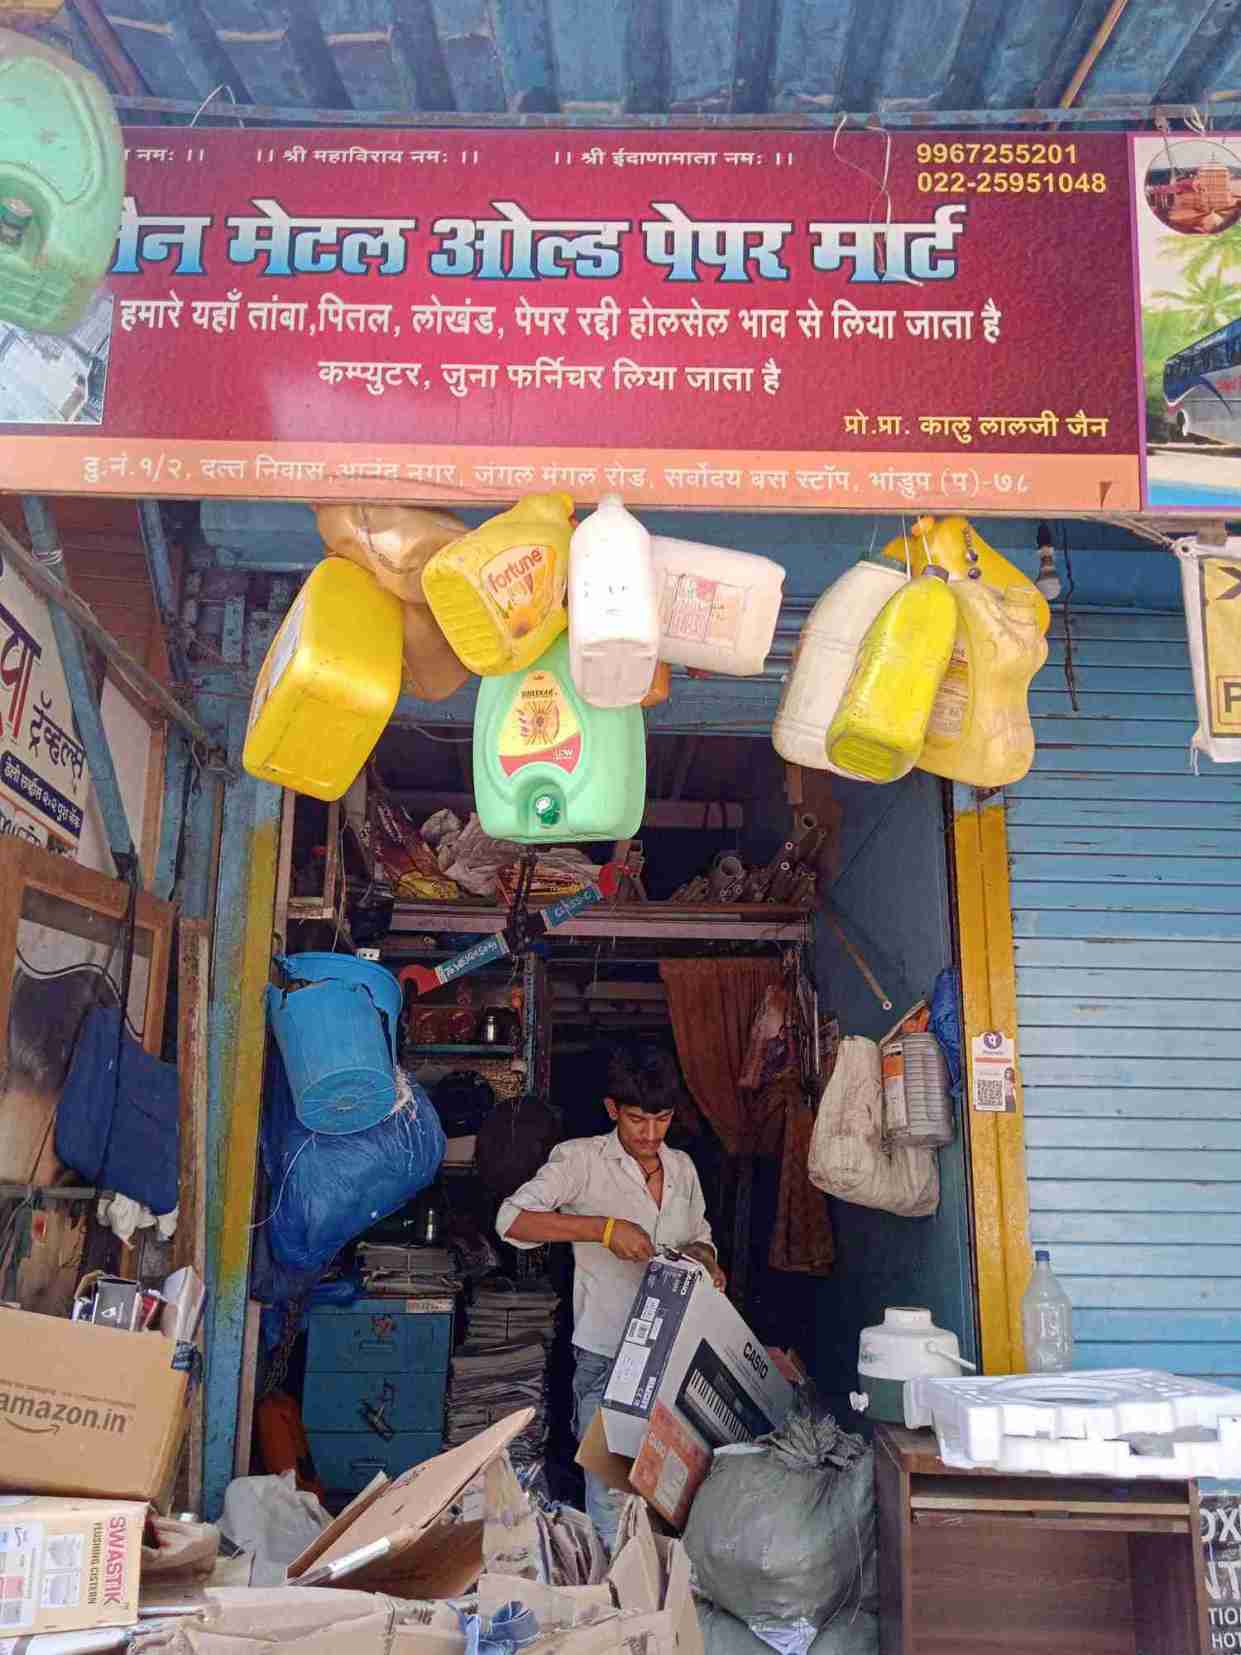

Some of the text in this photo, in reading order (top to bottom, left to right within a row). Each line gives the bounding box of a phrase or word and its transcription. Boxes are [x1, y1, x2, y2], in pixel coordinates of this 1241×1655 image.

[282, 145, 306, 164] श्री
[314, 146, 402, 165] महाविराय
[581, 147, 606, 167] श्री
[916, 143, 1078, 166] 9967255201
[916, 171, 1107, 195] 022-25951048
[226, 198, 417, 276] मेटल
[431, 202, 631, 281] ओल्ड
[642, 202, 794, 283] पेपर
[808, 204, 968, 284] मार्ट
[119, 289, 184, 331] हमारे
[191, 288, 240, 333] यहाँ
[514, 296, 570, 336] पेपर
[575, 296, 622, 340] रद्दी
[628, 296, 732, 340] होलसेल
[738, 307, 790, 339] भाव
[796, 298, 824, 339] से
[831, 299, 897, 340] लिया
[904, 309, 975, 340] जाता
[981, 297, 1002, 344] है
[440, 361, 499, 397] जुना
[612, 358, 675, 392] लिया
[685, 366, 754, 394] जाता
[761, 357, 782, 396] है
[918, 415, 973, 444] कालु
[977, 409, 1060, 438] लालजी
[1064, 409, 1110, 438] जैन
[486, 548, 543, 593] fortune
[743, 1341, 769, 1379] CASIO
[0, 1390, 128, 1433] amazon.in
[102, 1515, 128, 1608] SWASTIK
